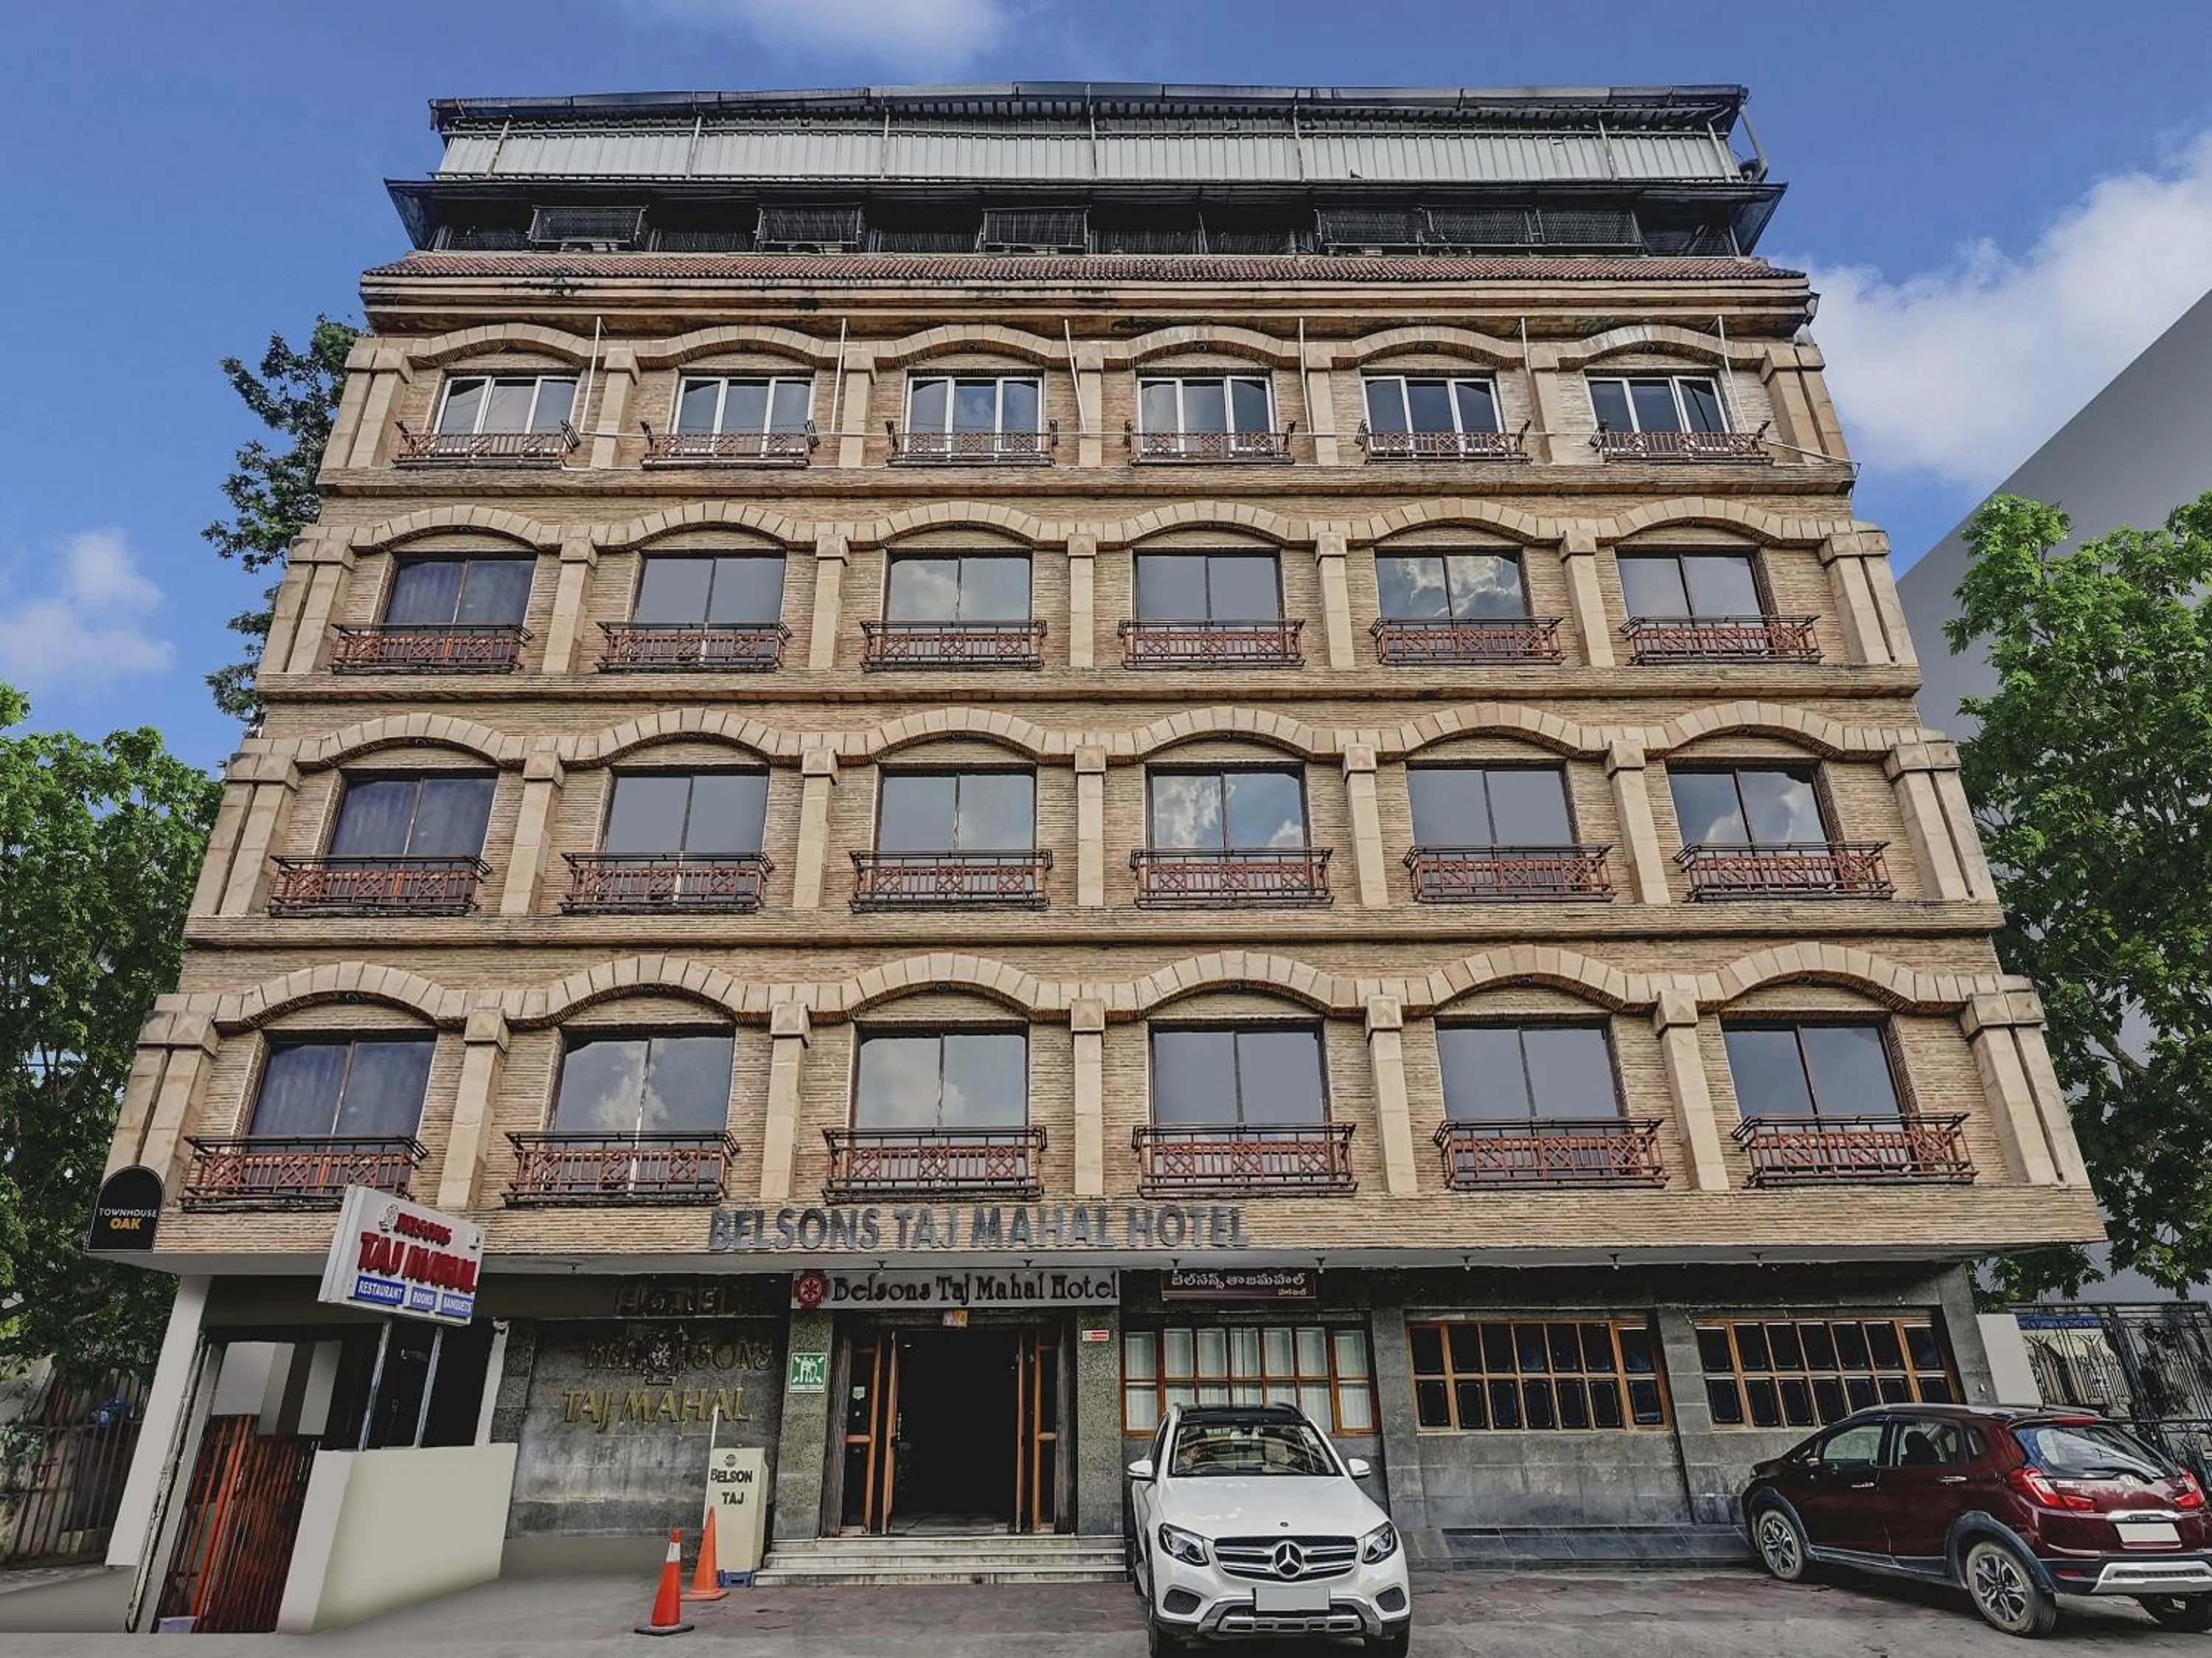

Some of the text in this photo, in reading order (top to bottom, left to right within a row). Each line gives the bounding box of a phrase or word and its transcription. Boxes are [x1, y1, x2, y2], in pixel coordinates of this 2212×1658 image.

[99, 1207, 156, 1217] TOWNHOUSE
[110, 1218, 142, 1229] OAK
[708, 1204, 1249, 1251] BELSONS TAJ MAHAL HOTEL
[357, 1280, 403, 1303] RESTAURANT
[832, 1271, 1119, 1305] Belsons Taj Mahal Hotel
[412, 1291, 435, 1305] ROOMS
[443, 1297, 472, 1313] BANQUETS
[563, 1387, 753, 1433] TAJ MAHAL
[710, 1468, 753, 1483] BELSON
[722, 1491, 744, 1505] TAJ
